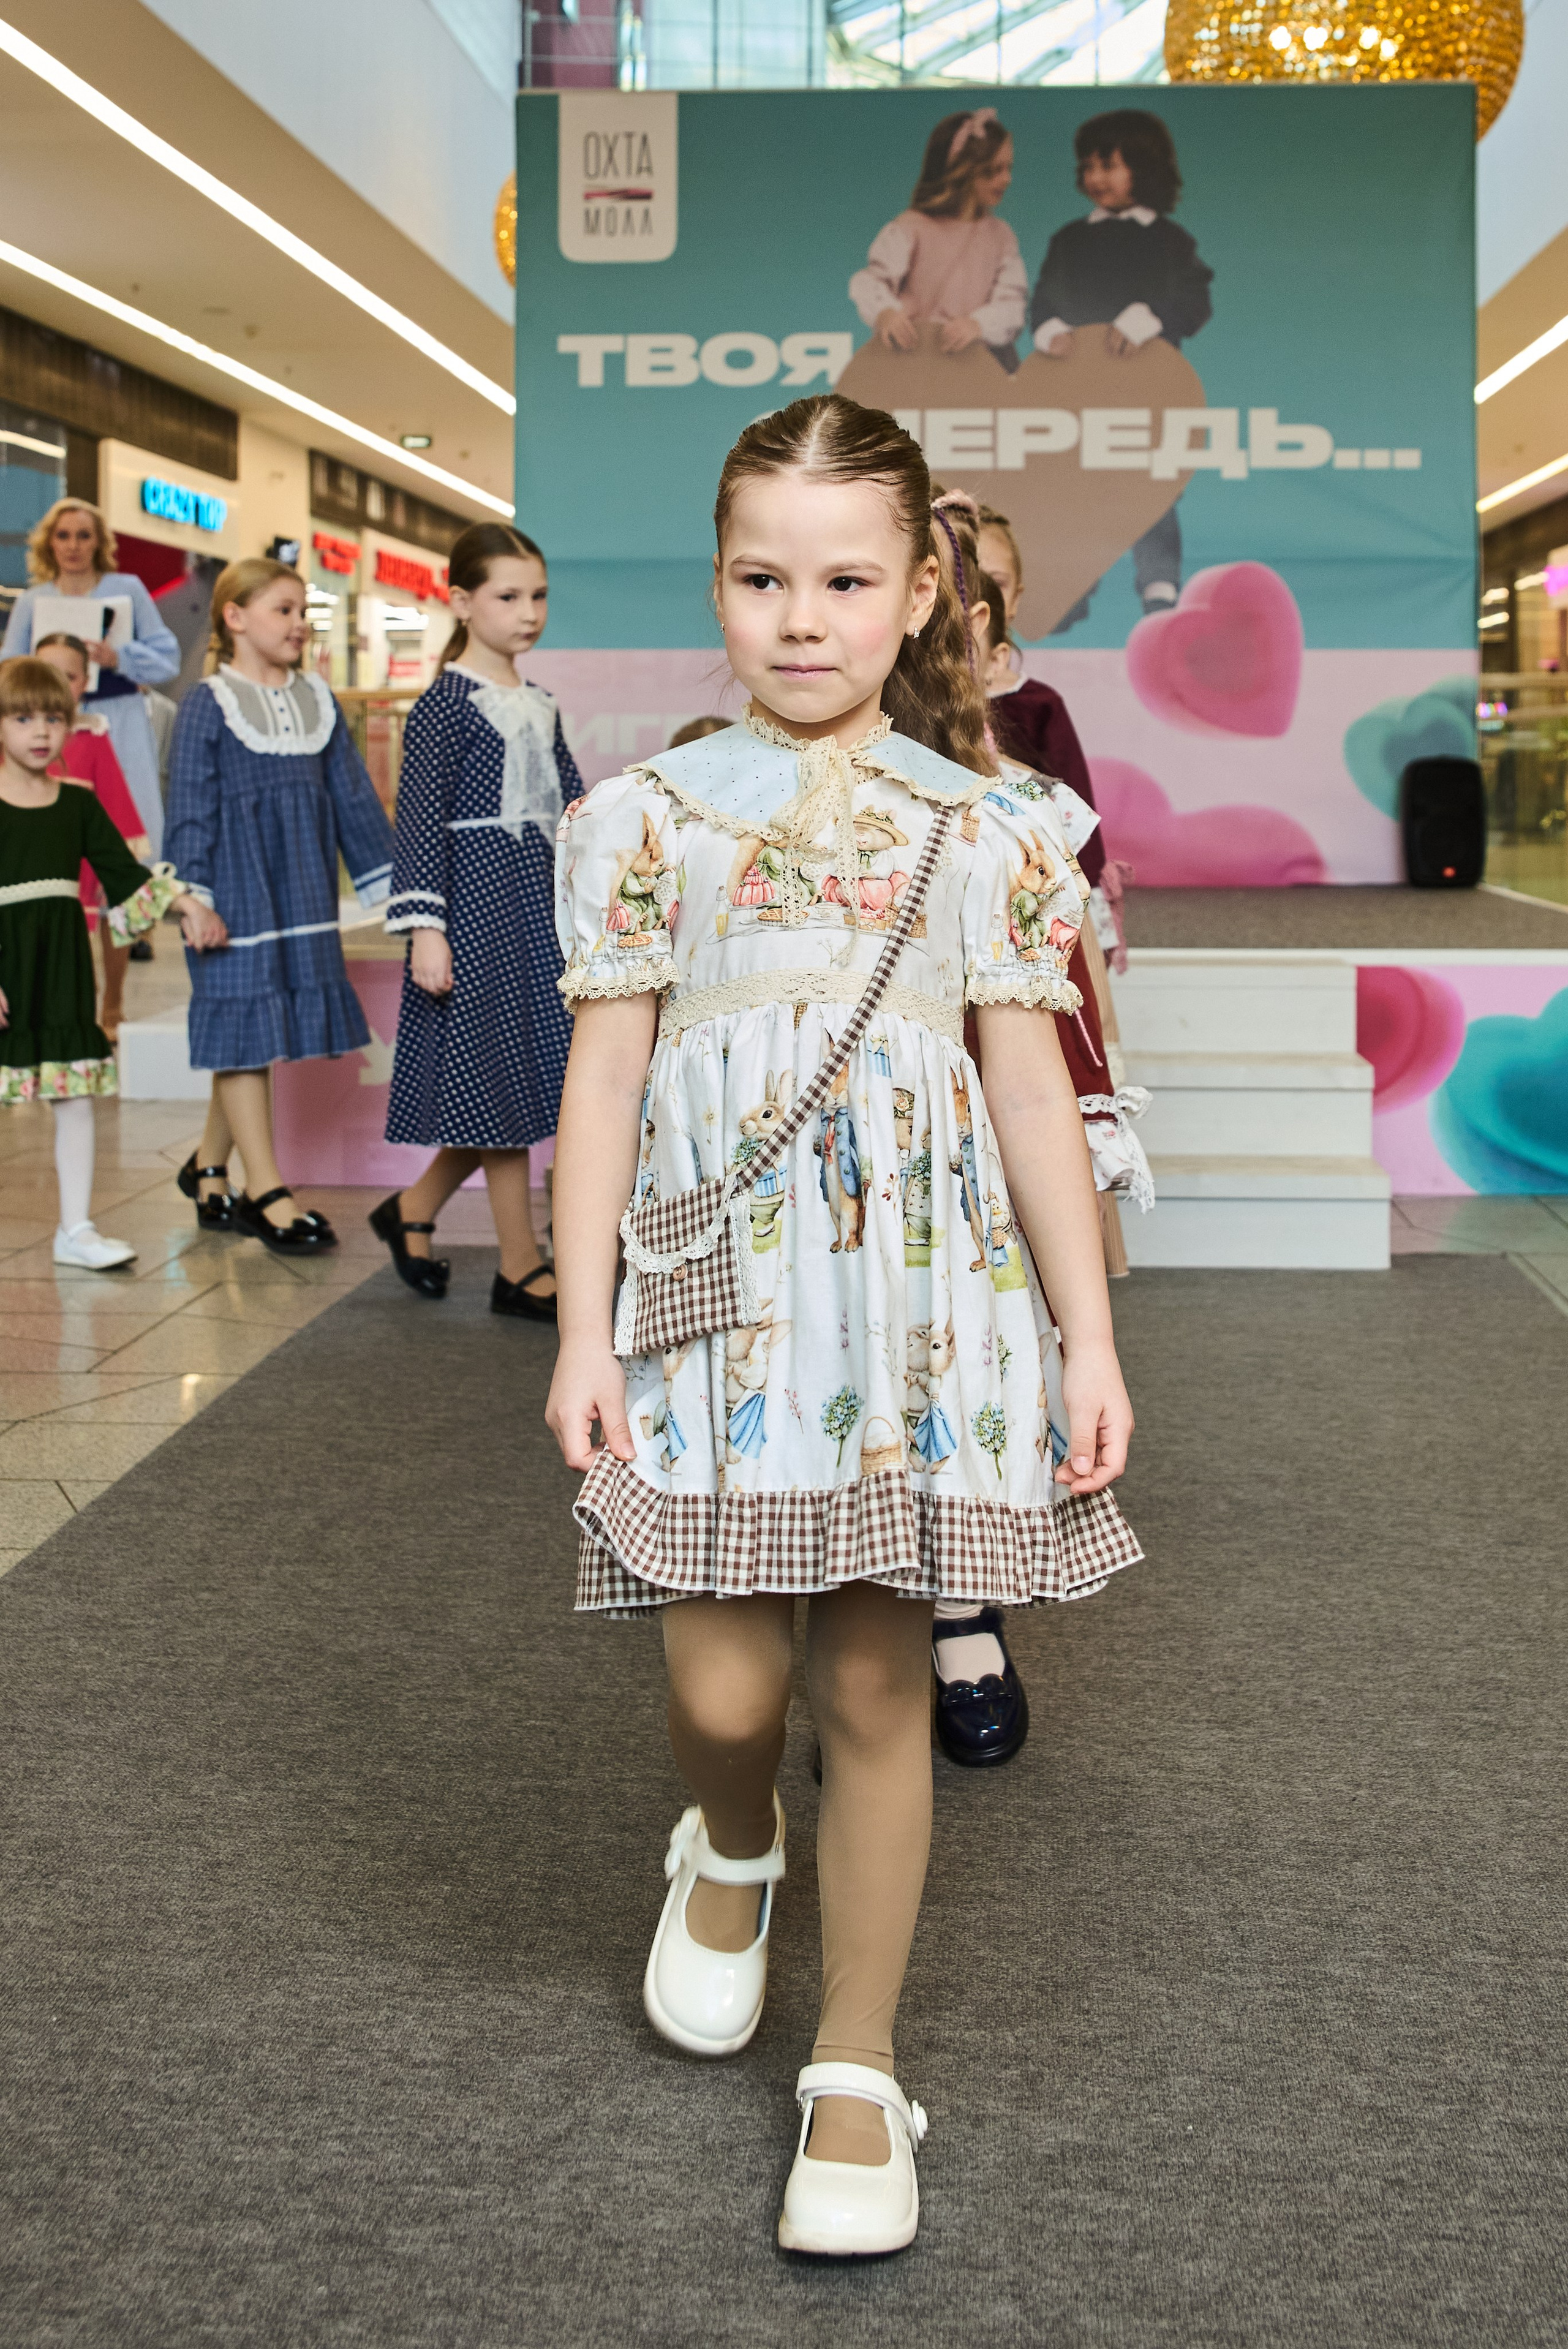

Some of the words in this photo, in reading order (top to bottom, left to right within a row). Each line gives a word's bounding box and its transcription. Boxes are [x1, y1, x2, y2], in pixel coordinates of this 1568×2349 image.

[583, 130, 654, 180] ОХТА
[583, 205, 654, 238] МОЛЛ
[557, 331, 853, 388] ТВОЯ
[750, 407, 1422, 479] ЕРЕДЬ...
